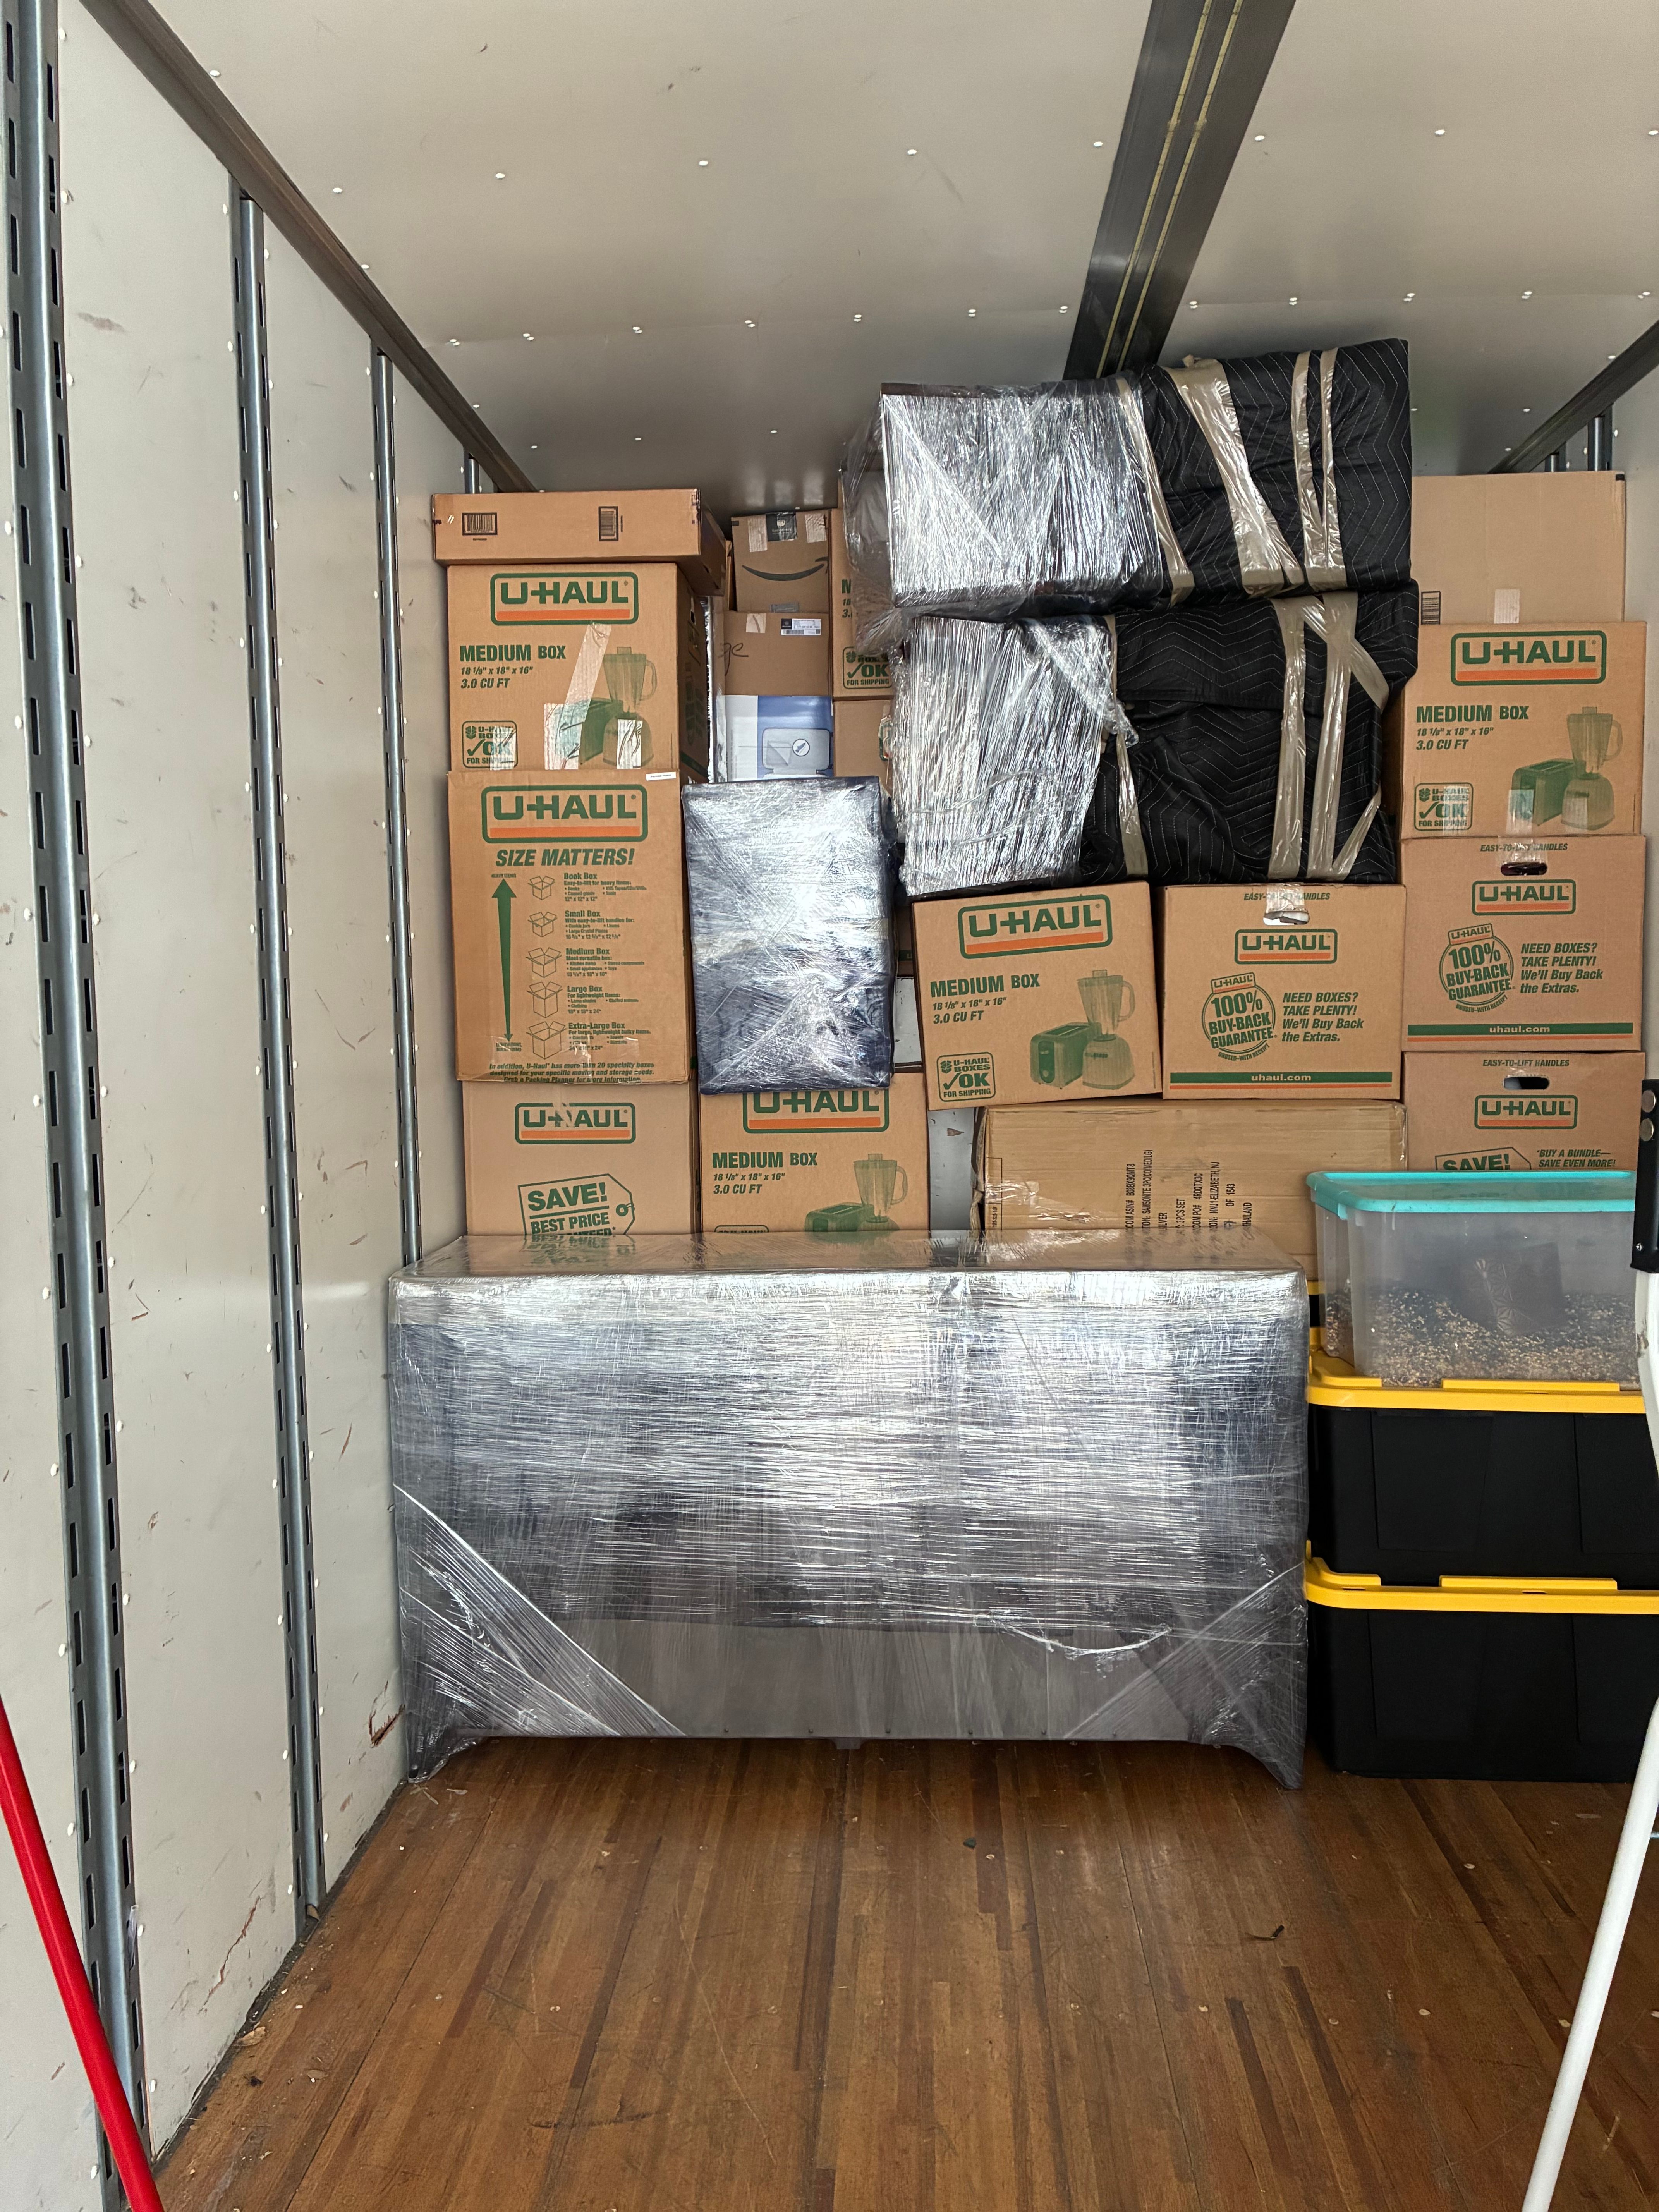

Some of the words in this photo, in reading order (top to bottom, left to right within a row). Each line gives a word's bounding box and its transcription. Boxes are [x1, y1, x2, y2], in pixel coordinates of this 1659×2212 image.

[501, 581, 628, 605] U-HAUL
[460, 645, 531, 661] MEDIUM
[538, 645, 566, 659] BOX
[1462, 640, 1595, 664] U-HAUL
[861, 664, 889, 677] OK
[461, 678, 477, 688] 3.0
[480, 678, 494, 688] CU
[497, 678, 510, 688] FT
[1417, 705, 1492, 723] MEDIUM
[1500, 706, 1529, 719] BOX
[1454, 728, 1469, 736] 18"
[1416, 740, 1433, 750] 3.0
[1436, 740, 1452, 750] CU
[1454, 739, 1469, 749] FT
[493, 794, 636, 819] U-HAUL
[496, 849, 536, 866] SIZE
[541, 848, 635, 866] MATTERS!
[1480, 886, 1569, 901] U-HAUL
[969, 905, 1101, 937] U-HAUL
[1451, 926, 1490, 939] U-HAUL
[1242, 935, 1330, 950] U-HAUL
[1521, 943, 1551, 953] NEED
[1554, 943, 1597, 953] BOXES?
[1449, 941, 1501, 969] 100%
[1522, 957, 1549, 967] TAKE
[1551, 956, 1597, 966] PLENTY!
[1214, 975, 1252, 988] U-HAUL
[1446, 963, 1509, 987] BUY-BACK
[1521, 970, 1548, 980] We'll
[1551, 970, 1573, 982] Buy
[1575, 969, 1603, 979] Back
[930, 975, 1004, 998] MEDIUM
[1011, 974, 1040, 988] BOX
[1448, 979, 1511, 1000] GUARANTEE
[1520, 983, 1538, 993] the
[1541, 983, 1579, 993] Extras.
[969, 999, 982, 1007] 18"
[993, 997, 1007, 1005] 16"
[1211, 990, 1263, 1018] 100%
[1283, 993, 1312, 1003] NEED
[1316, 992, 1358, 1002] BOXES?
[933, 1013, 950, 1024] 3.0
[953, 1012, 967, 1022] CU
[970, 1010, 984, 1020] FT
[1283, 1006, 1310, 1015] TAKE
[1313, 1005, 1357, 1015] PLENTY!
[1209, 1012, 1271, 1035] BUY-BACK
[1283, 1018, 1309, 1029] We'll
[1312, 1018, 1333, 1030] Buy
[1336, 1018, 1364, 1029] Back
[1211, 1027, 1273, 1048] GUARANTEE
[1282, 1032, 1300, 1042] the
[1303, 1032, 1340, 1042] Extras.
[953, 1058, 989, 1066] U-HAUL
[959, 1073, 990, 1088] OK
[753, 1090, 879, 1113] U-HAUL
[1482, 1101, 1571, 1115] U-HAUL
[713, 1152, 783, 1168] MEDIUM
[790, 1152, 817, 1166] BOX
[1443, 1154, 1510, 1170] SAVE!
[528, 1182, 607, 1211] SAVE!
[713, 1184, 730, 1194] 3.0
[733, 1184, 746, 1194] CU
[749, 1184, 762, 1194] FT
[1226, 1183, 1235, 1195] 1543
[1142, 1188, 1151, 1214] SAMSONITE
[1176, 1199, 1185, 1208] SET
[531, 1218, 565, 1234] BEST
[569, 1212, 610, 1229] PRICE
